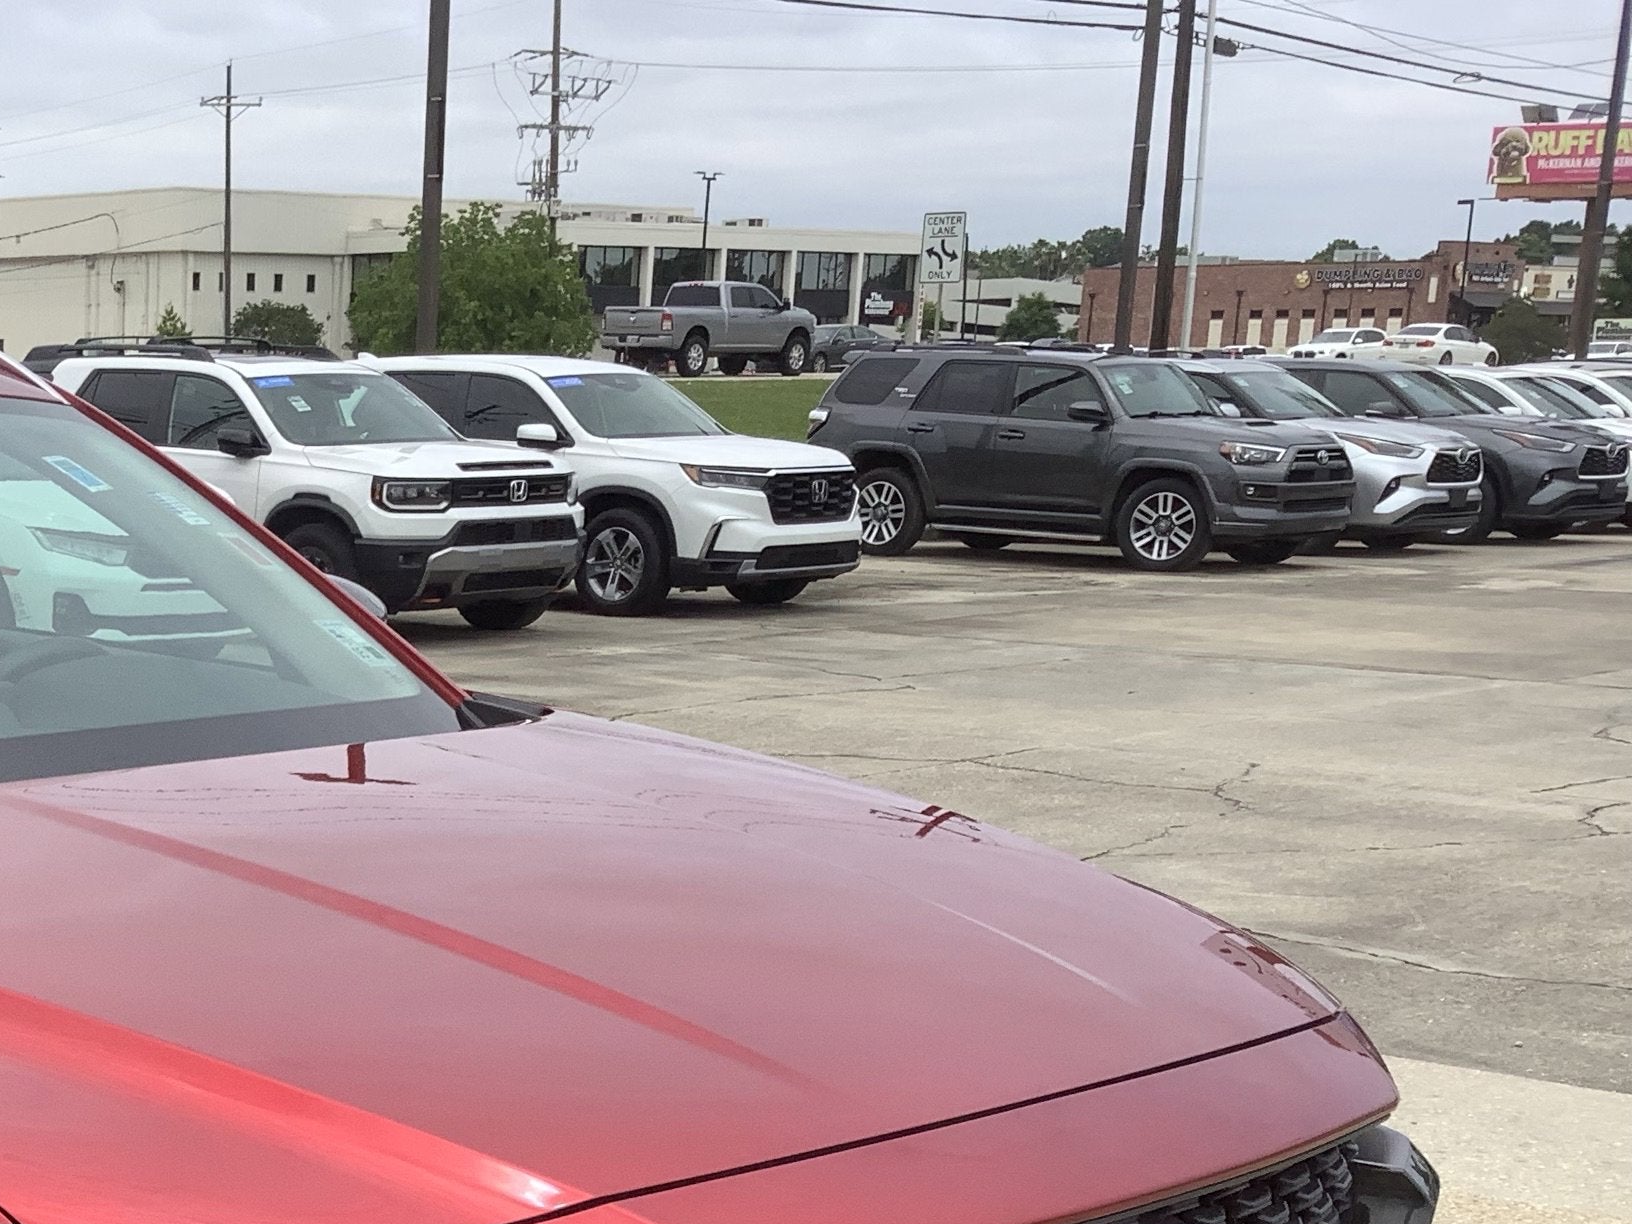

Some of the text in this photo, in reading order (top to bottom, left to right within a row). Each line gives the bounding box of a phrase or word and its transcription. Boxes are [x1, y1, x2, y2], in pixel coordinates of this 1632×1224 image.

[1531, 130, 1595, 156] RUFF
[927, 216, 962, 225] CENTER
[931, 226, 956, 235] LANE
[927, 271, 953, 279] ONLY
